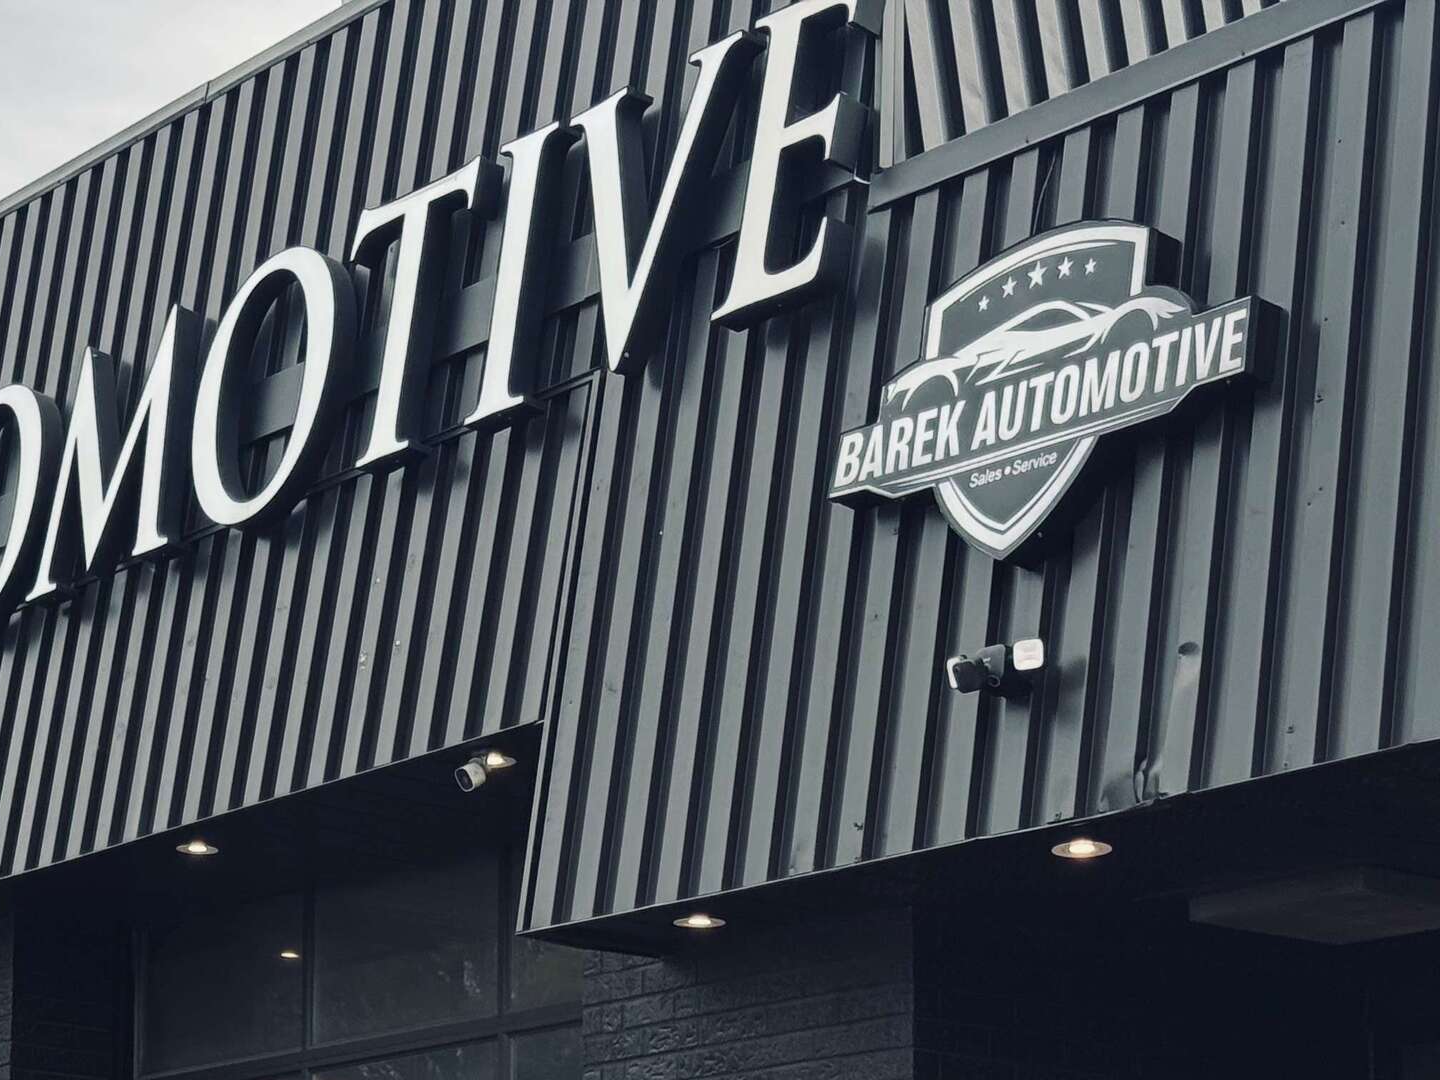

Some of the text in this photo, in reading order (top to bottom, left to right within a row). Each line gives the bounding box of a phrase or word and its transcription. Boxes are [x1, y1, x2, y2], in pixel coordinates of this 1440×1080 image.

[834, 308, 1247, 488] BAREK AUTOMOTIVE
[969, 451, 1058, 489] Sales Service
